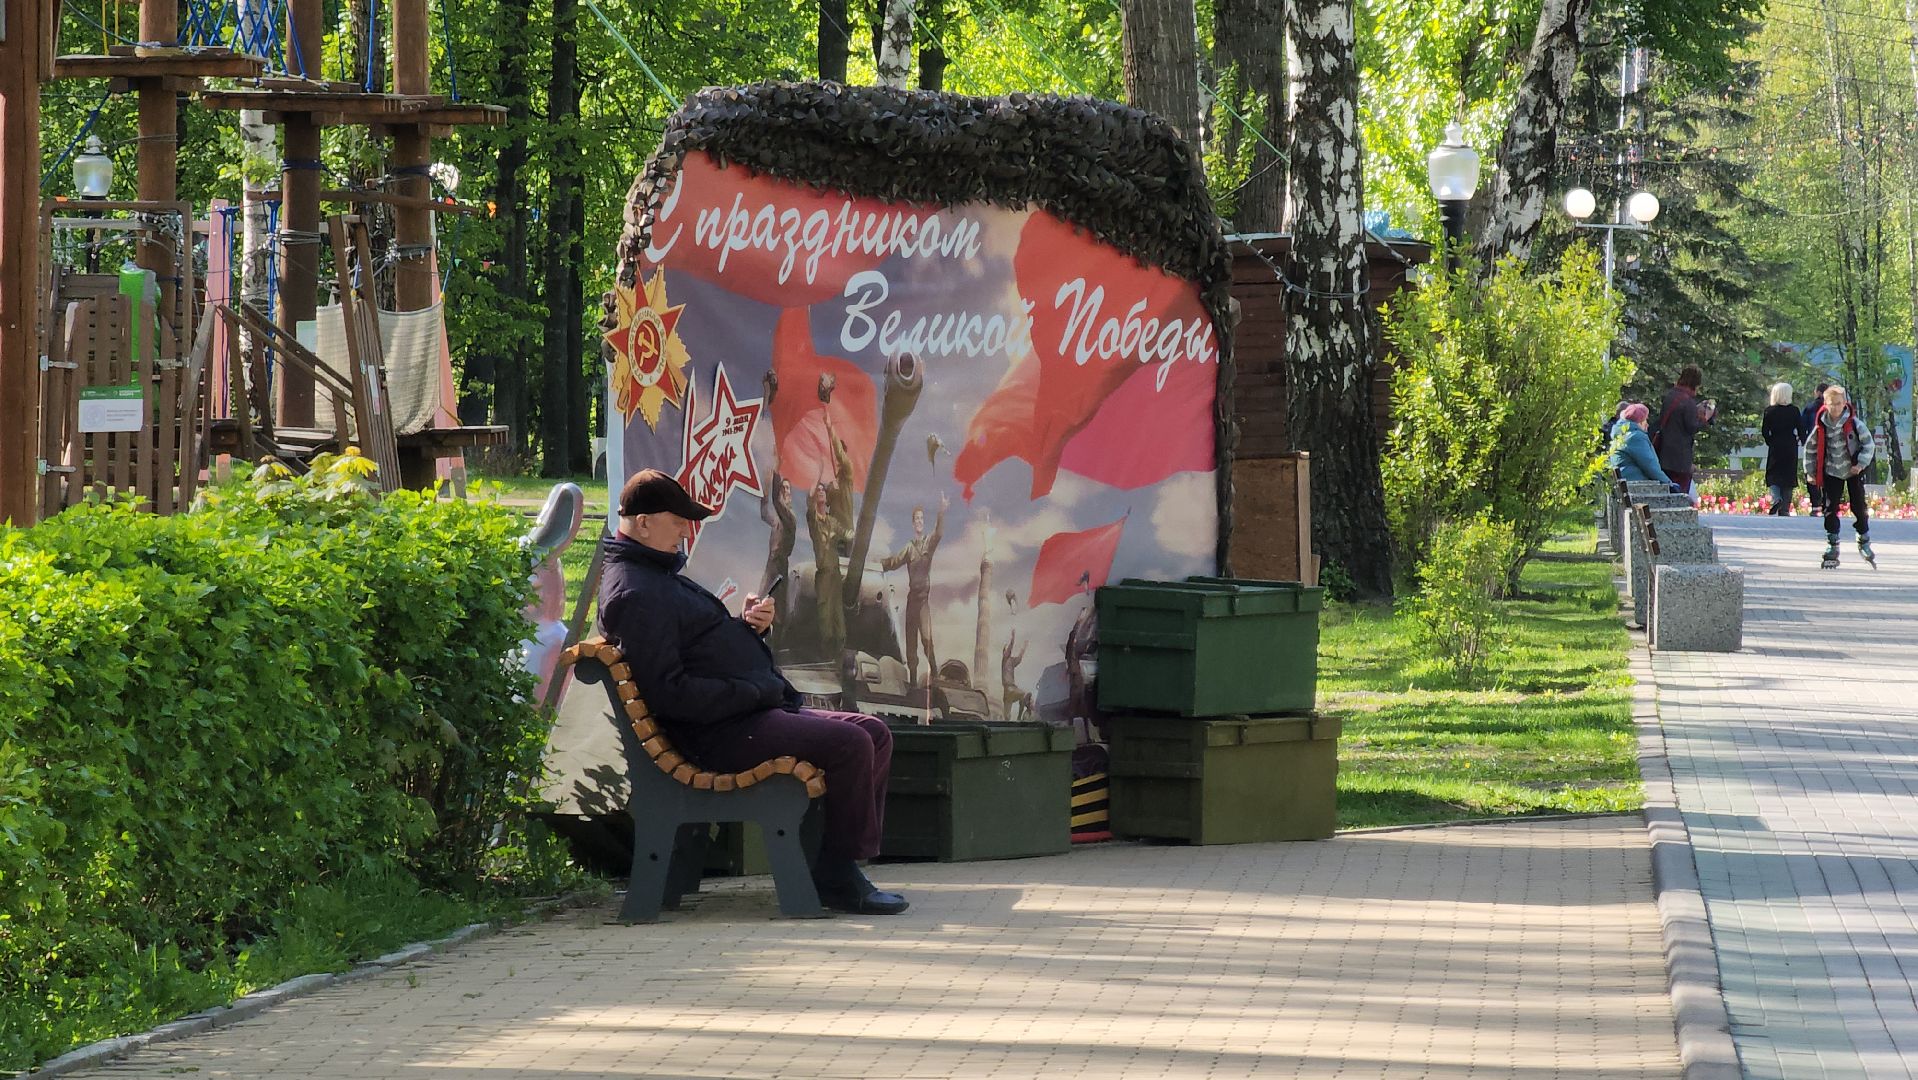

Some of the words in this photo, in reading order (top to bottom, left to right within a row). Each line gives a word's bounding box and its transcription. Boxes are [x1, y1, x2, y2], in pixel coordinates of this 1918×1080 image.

[695, 192, 981, 286] праздником
[840, 271, 1035, 358] Великой
[1055, 277, 1220, 392] Победы
[725, 416, 731, 428] 9
